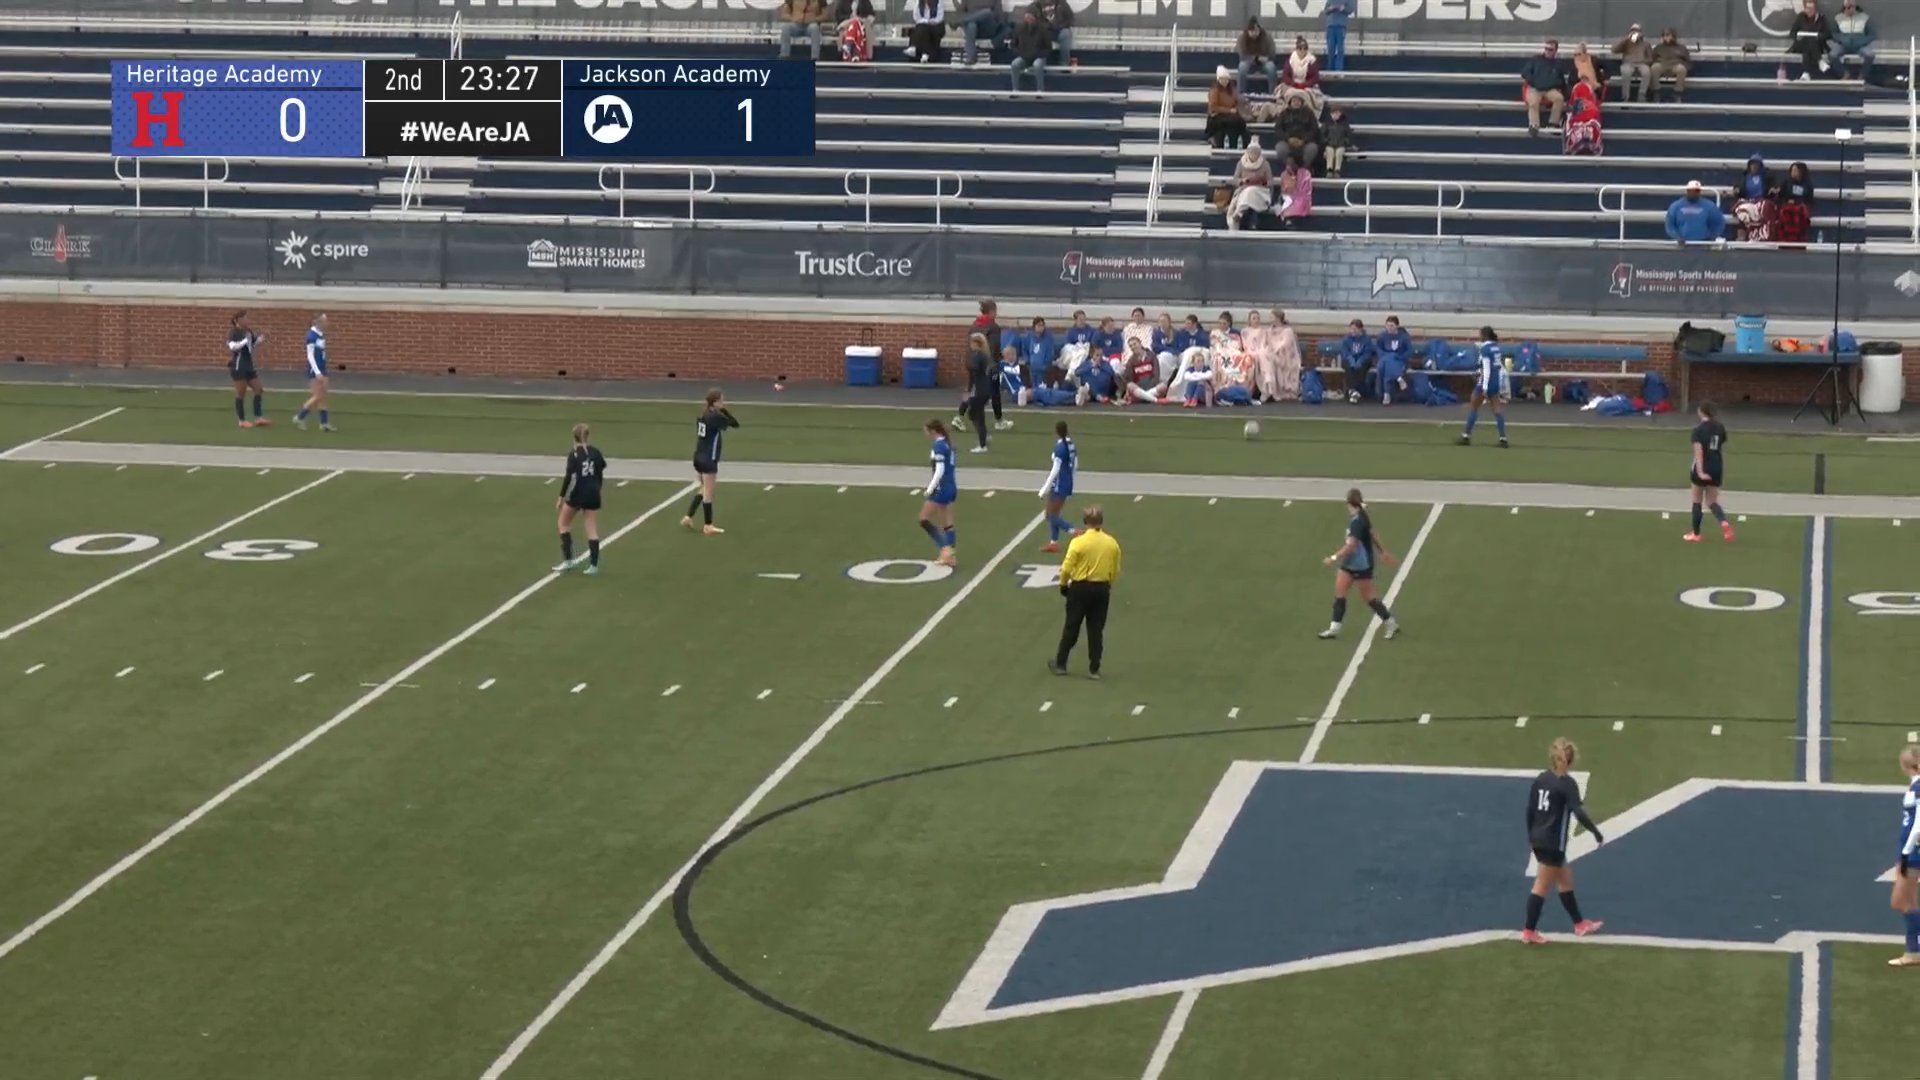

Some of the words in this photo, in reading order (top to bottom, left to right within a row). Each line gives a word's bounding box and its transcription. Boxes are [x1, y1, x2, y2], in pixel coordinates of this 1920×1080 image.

[323, 243, 369, 260] spire
[559, 246, 645, 258] MISSISSIPPI
[559, 257, 600, 267] SMART
[603, 258, 646, 269] HOMES
[794, 250, 912, 276] TrustCare
[1085, 256, 1125, 268] Mississippi
[1127, 256, 1150, 268] Sports
[1152, 257, 1185, 267] Medicine
[1371, 257, 1419, 298] JA
[1635, 269, 1677, 281] Mississippi
[1678, 269, 1702, 281] Sports
[1703, 270, 1738, 280] Medicine
[582, 461, 594, 477] 24
[1537, 789, 1550, 811] 14
